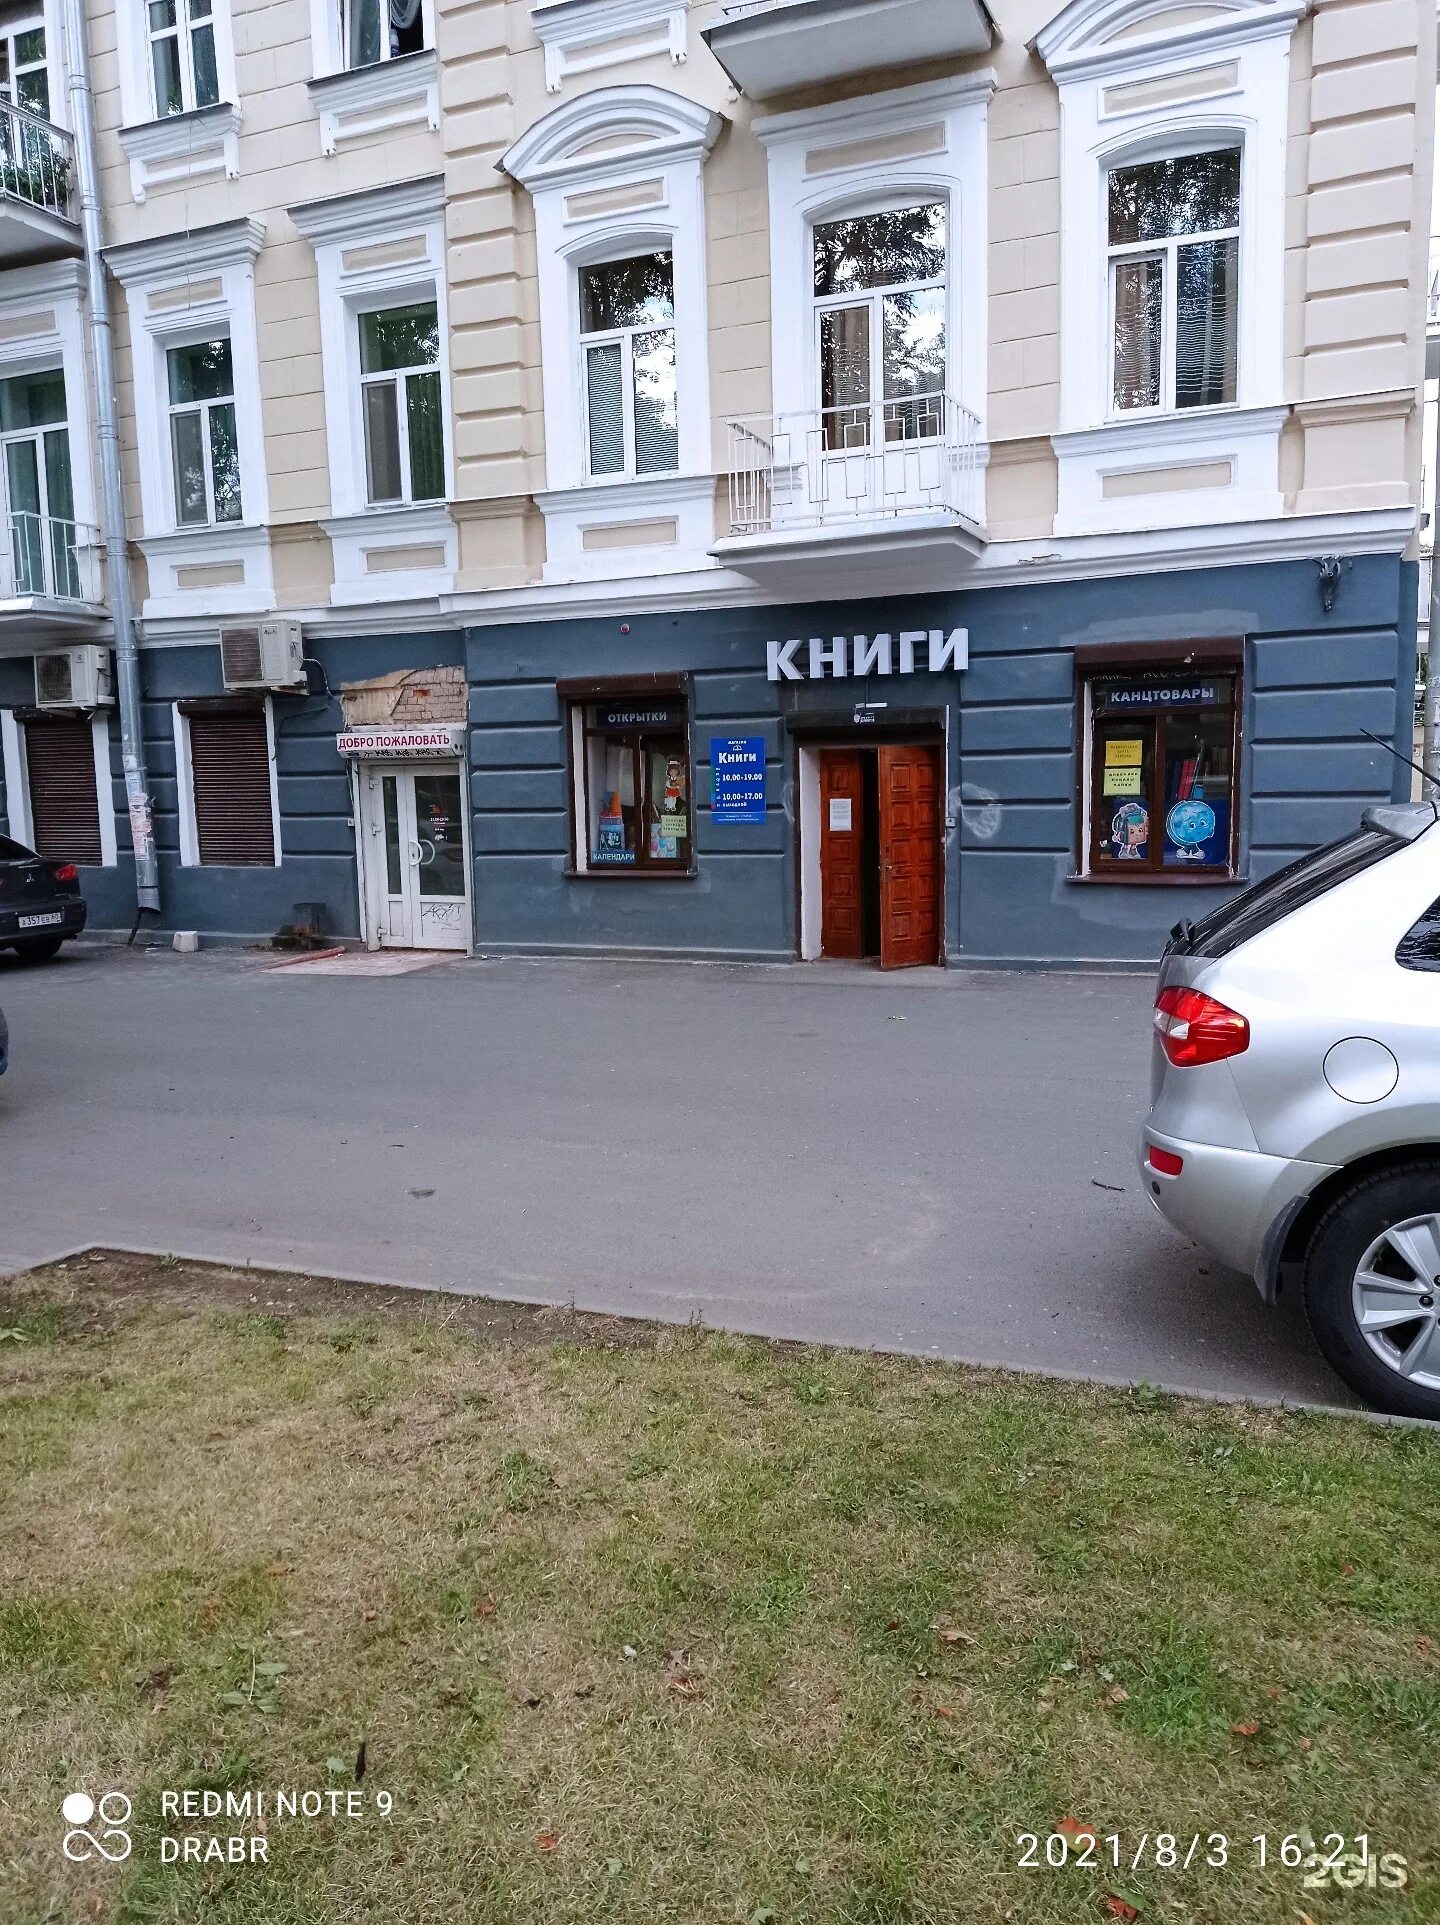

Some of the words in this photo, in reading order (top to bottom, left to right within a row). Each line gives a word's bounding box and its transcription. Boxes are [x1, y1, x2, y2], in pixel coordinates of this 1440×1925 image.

[767, 628, 969, 681] КНИГИ
[1111, 687, 1214, 702] КАНЦТОВАРЫ
[607, 711, 667, 723] ОТКРЫТКИ
[338, 737, 374, 750] ДОБРО
[376, 734, 450, 747] ПОЖАЛОВАТЬ
[722, 773, 763, 782] 10.00-19.00
[593, 853, 635, 861] КАЛЕНДАРИ
